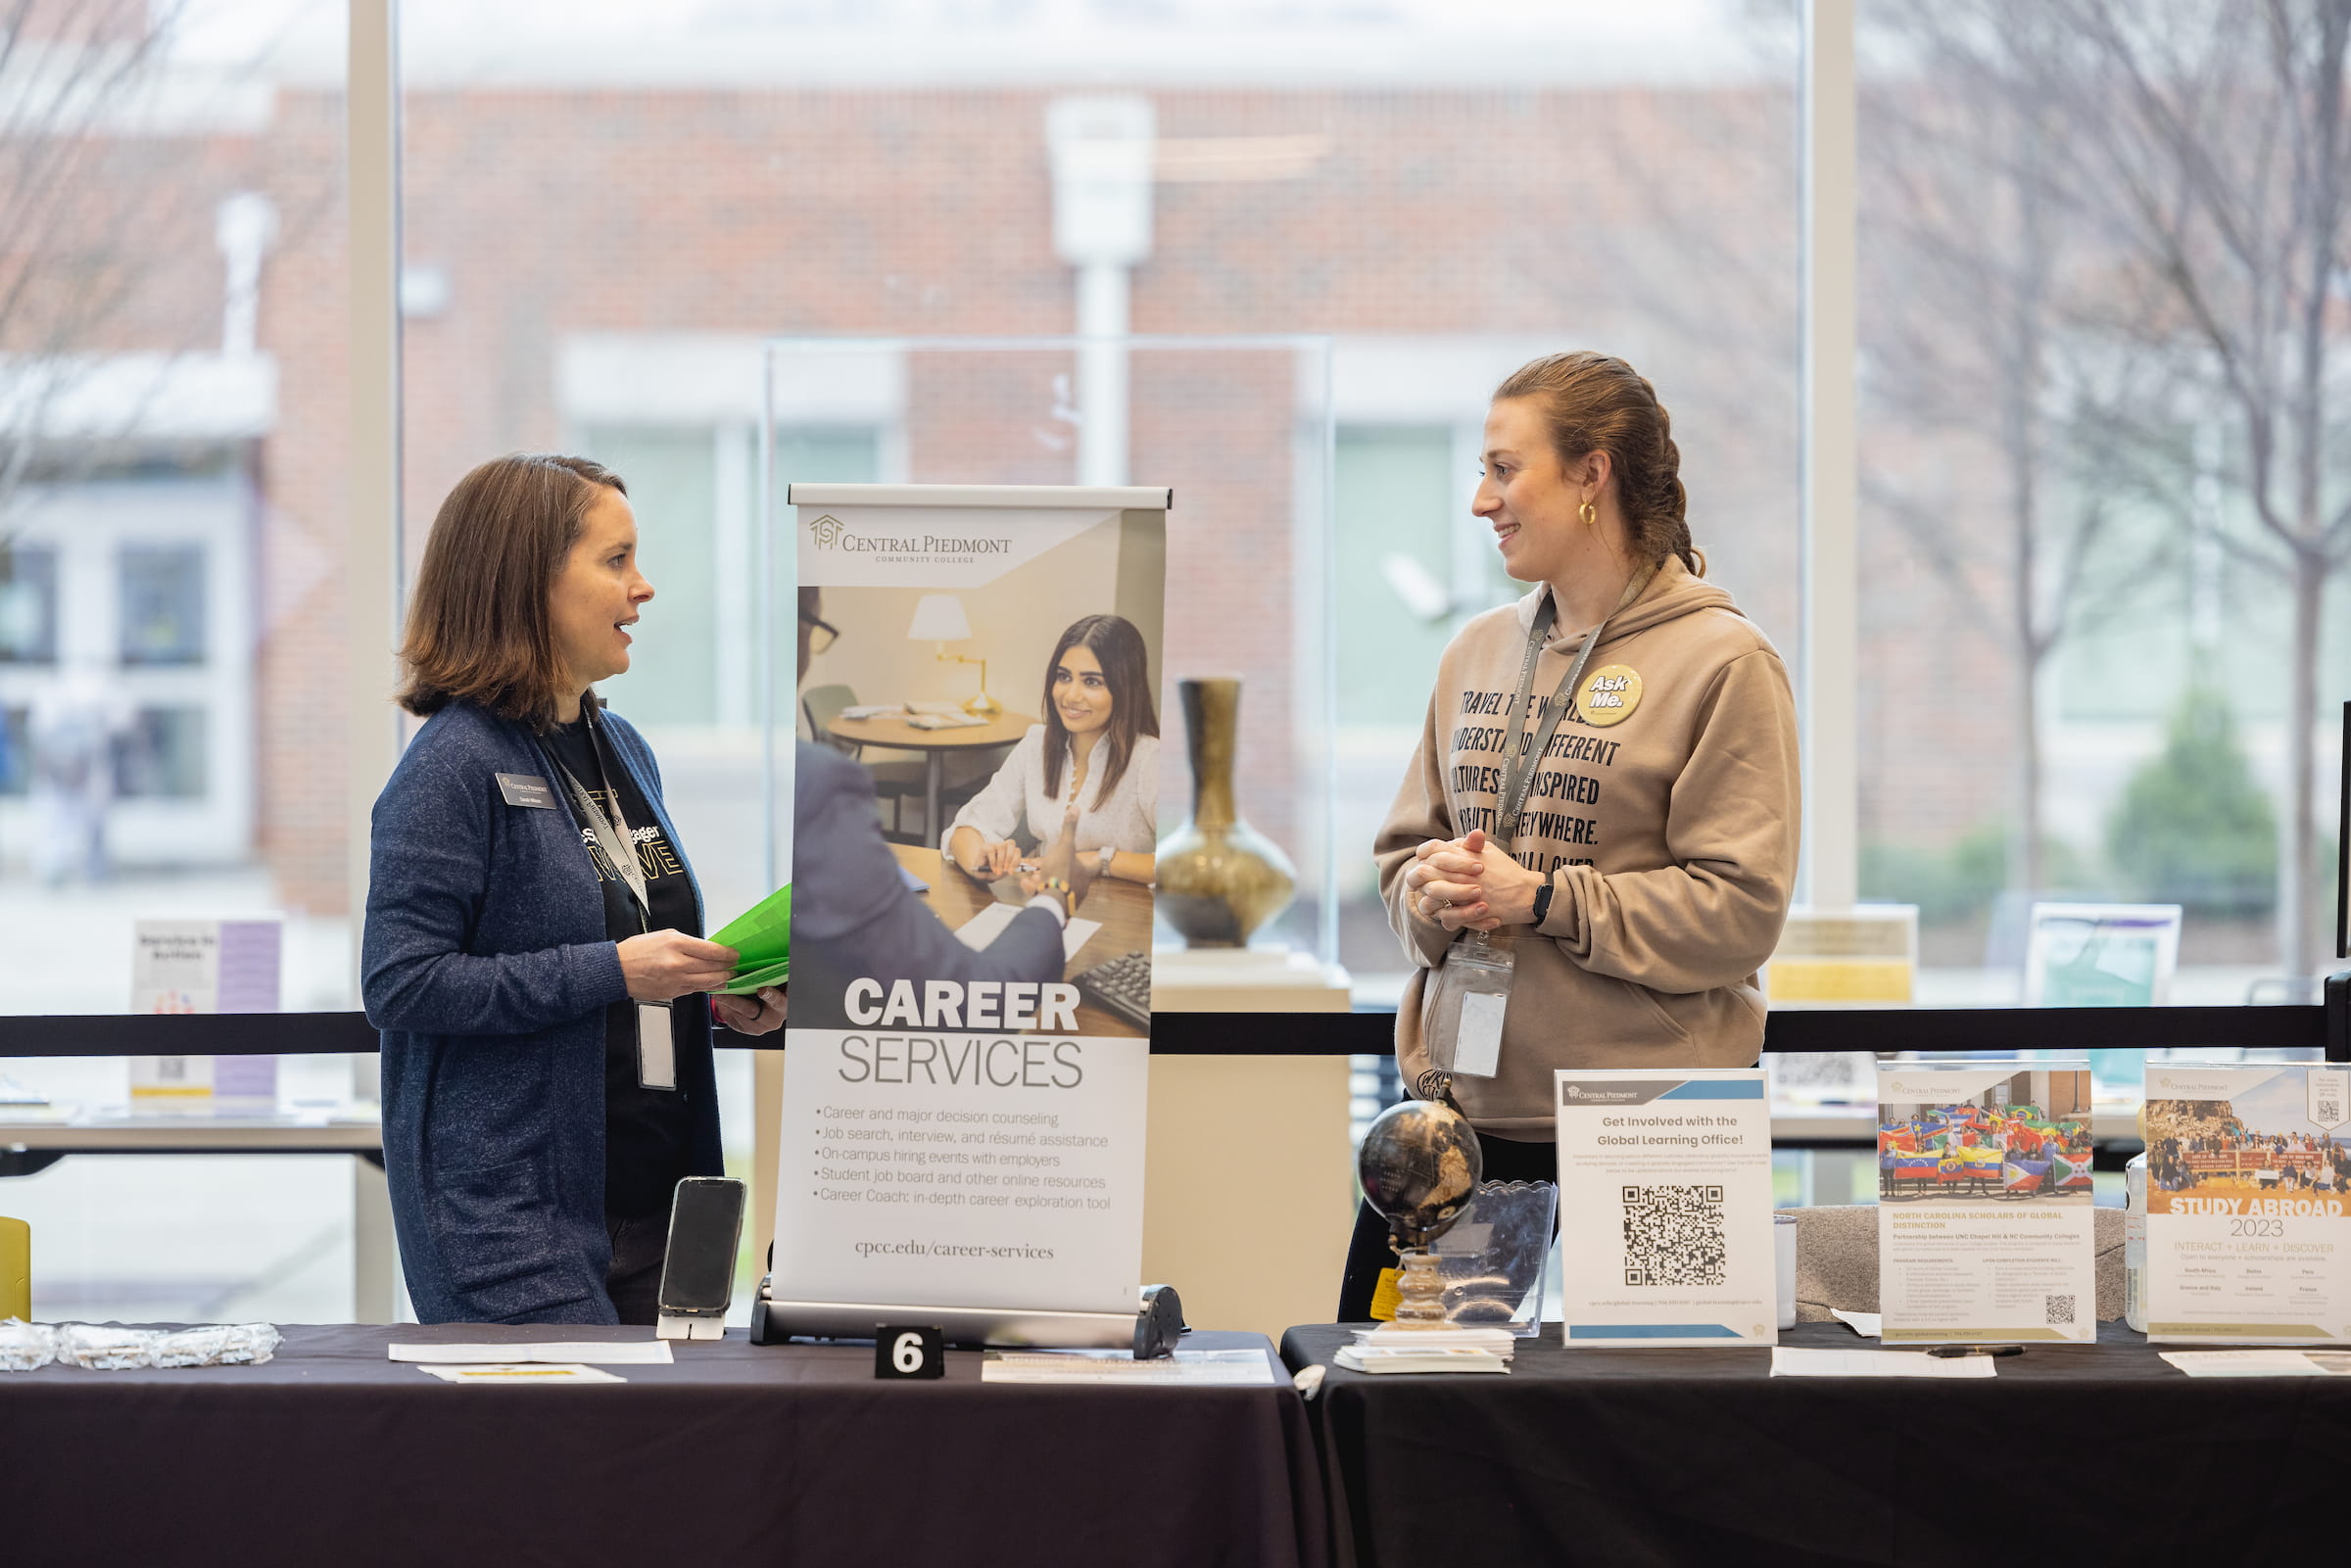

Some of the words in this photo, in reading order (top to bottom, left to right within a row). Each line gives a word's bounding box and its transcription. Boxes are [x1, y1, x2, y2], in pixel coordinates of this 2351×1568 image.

[842, 535, 920, 552] CENTRAL
[924, 536, 1012, 553] PIEDMONT
[1589, 676, 1627, 691] Ask
[1461, 690, 1504, 715] TRAVEL
[1505, 694, 1536, 719] TE
[1589, 692, 1623, 708] Me.
[844, 977, 1080, 1030] CAREER
[839, 1035, 1082, 1088] SERVICES
[823, 1106, 865, 1120] Career
[869, 1108, 893, 1121] and
[897, 1108, 933, 1125] major
[936, 1110, 988, 1123] decision
[992, 1111, 1059, 1128] counseling
[1603, 1117, 1624, 1127] Get
[1628, 1117, 1683, 1127] Involved
[1686, 1117, 1713, 1126] with
[1716, 1117, 1738, 1126] the
[822, 1127, 843, 1140] Job
[847, 1129, 893, 1142] search,
[897, 1129, 957, 1144] interview,
[961, 1131, 985, 1144] and
[988, 1130, 1036, 1145] résumé
[1039, 1132, 1108, 1147] assistance
[1598, 1135, 1640, 1146] Global
[1642, 1134, 1698, 1148] Learning
[1702, 1134, 1744, 1145] Office!
[821, 1147, 890, 1164] On-campus
[893, 1149, 927, 1165] hiring
[929, 1152, 969, 1164] events
[972, 1152, 996, 1165] with
[999, 1154, 1060, 1168] employers
[821, 1167, 870, 1181] Student
[873, 1168, 893, 1185] job
[897, 1170, 934, 1184] board
[937, 1171, 962, 1184] and
[965, 1172, 998, 1186] other
[1002, 1174, 1039, 1187] online
[1043, 1178, 1106, 1189] resources
[821, 1188, 862, 1202] Career
[866, 1189, 910, 1204] Coach:
[913, 1191, 966, 1207] in-depth
[969, 1194, 1009, 1207] career
[1015, 1195, 1083, 1212] exploration
[1087, 1197, 1111, 1211] tool
[2171, 1197, 2242, 1215] STUDY
[2247, 1199, 2343, 1217] ABROAD
[2231, 1218, 2284, 1238] 2023
[855, 1239, 1054, 1259] cpcc.edu/career-services
[2175, 1241, 2223, 1253] INTERACT
[2236, 1242, 2270, 1253] LEARN
[2282, 1243, 2334, 1254] DISCOVER
[892, 1332, 925, 1373] 6
